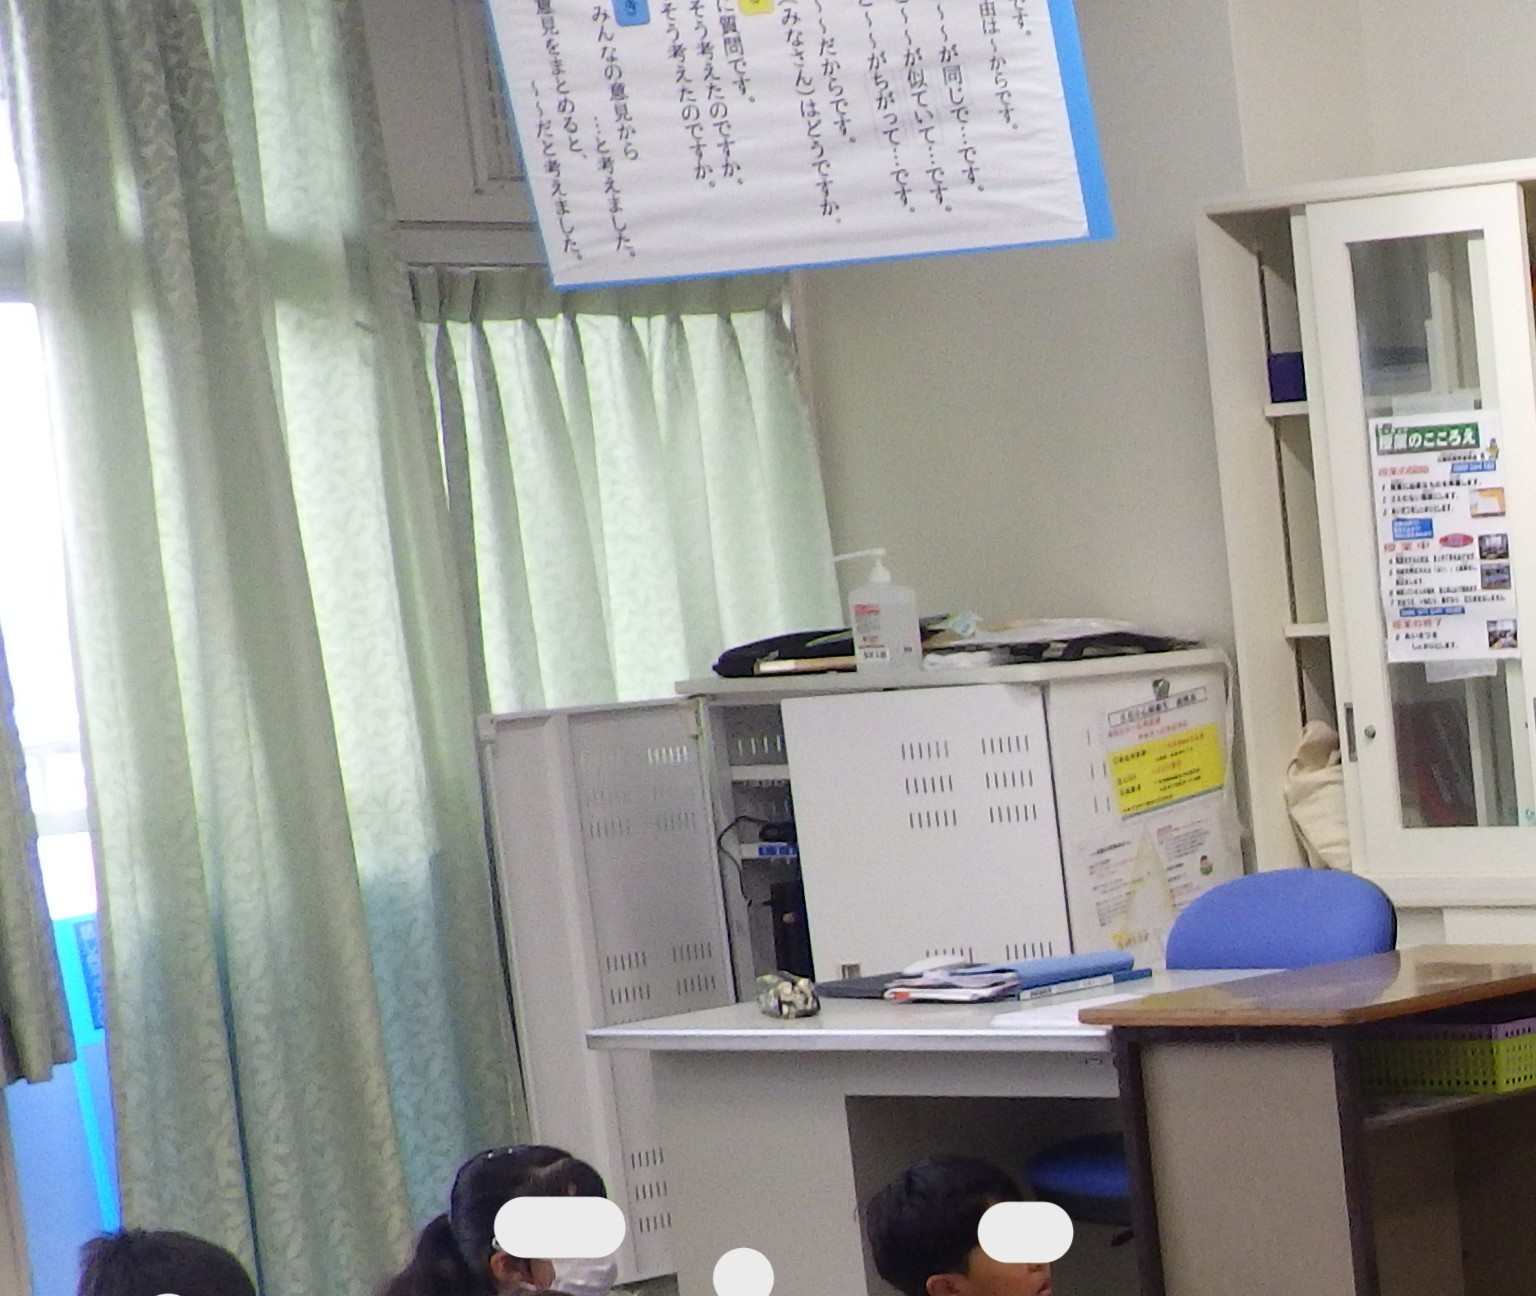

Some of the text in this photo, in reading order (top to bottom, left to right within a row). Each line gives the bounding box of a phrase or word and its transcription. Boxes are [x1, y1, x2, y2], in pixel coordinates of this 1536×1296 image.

[591, 6, 639, 161] みんなの意見から
